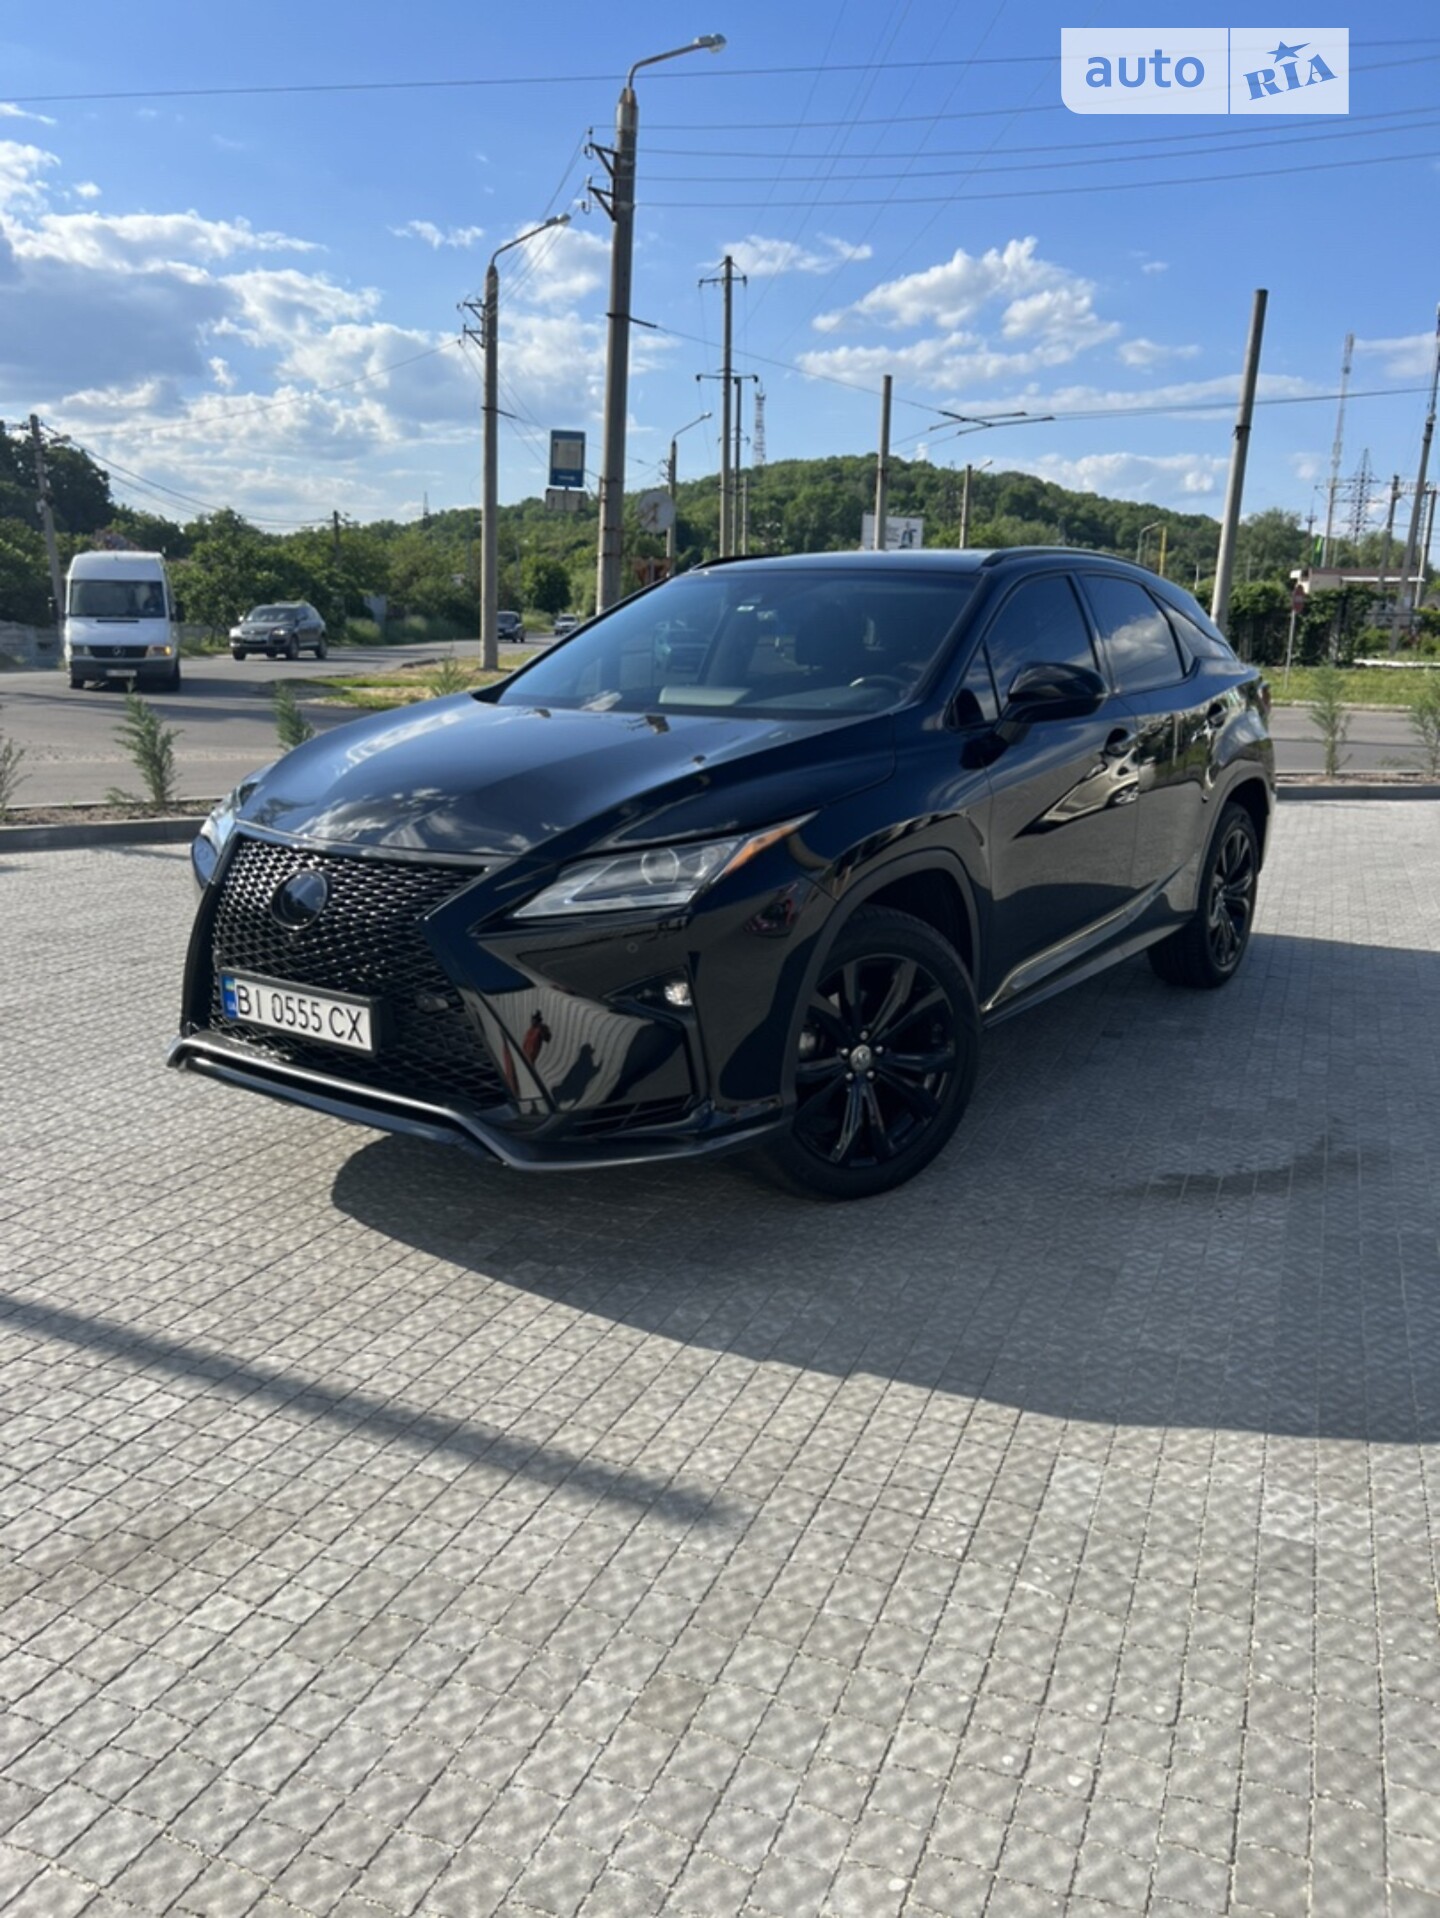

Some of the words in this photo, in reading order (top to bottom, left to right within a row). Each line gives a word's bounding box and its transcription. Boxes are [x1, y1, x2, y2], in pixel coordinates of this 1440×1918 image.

[236, 985, 262, 1019] BI
[271, 993, 322, 1032] 0555
[328, 1006, 363, 1044] CX
